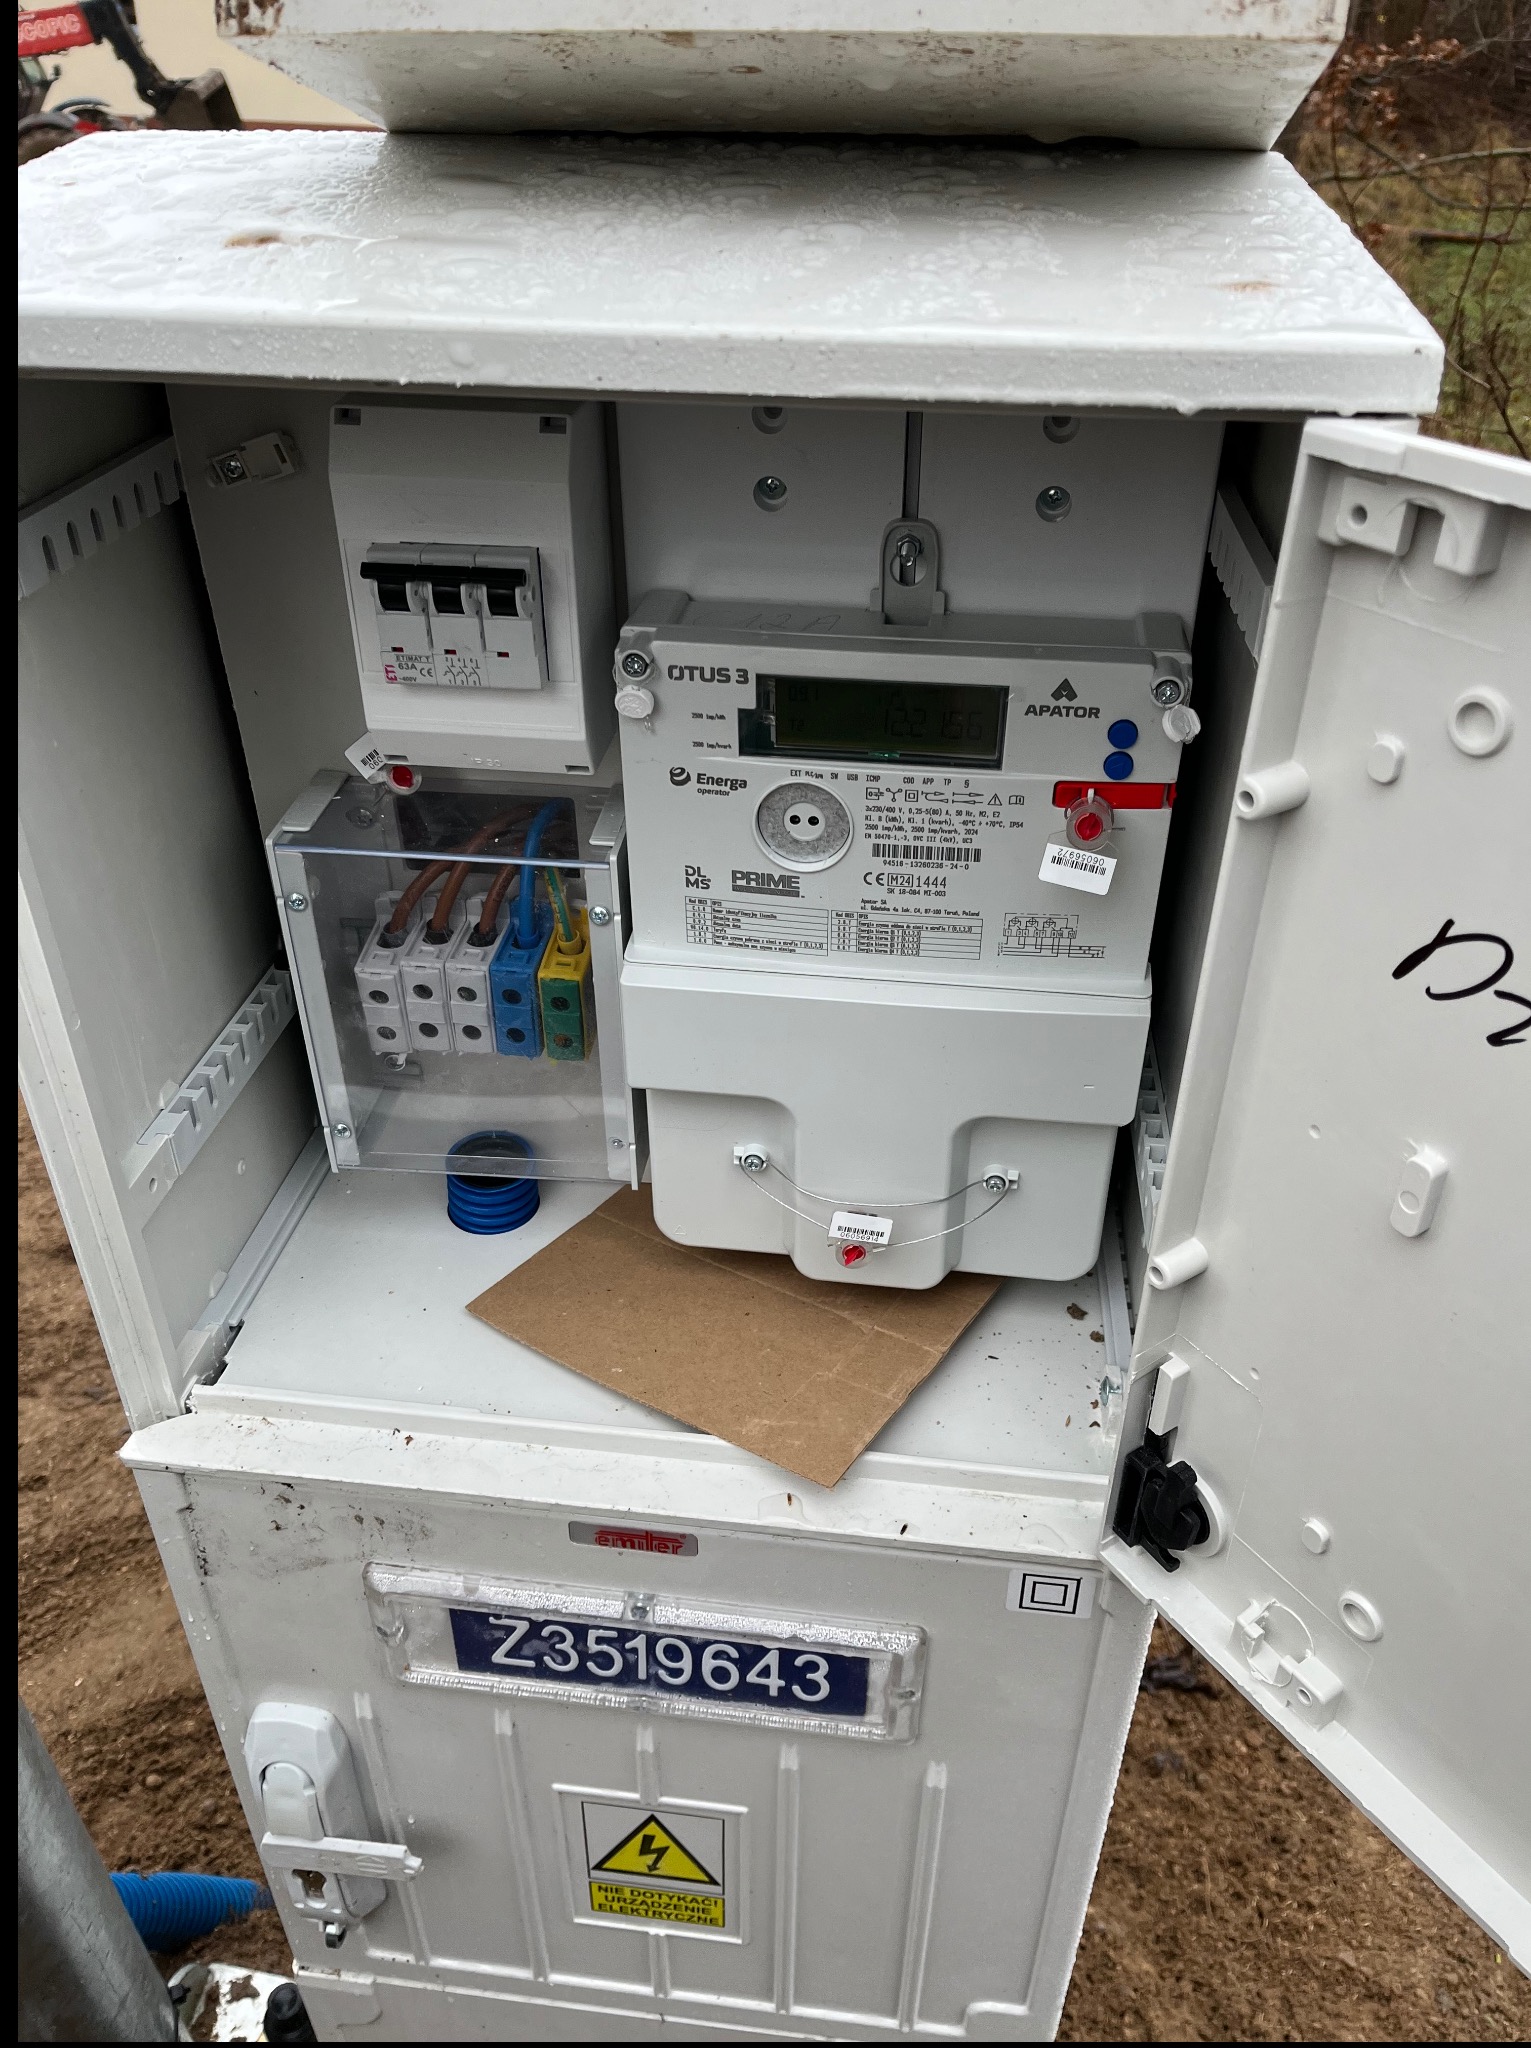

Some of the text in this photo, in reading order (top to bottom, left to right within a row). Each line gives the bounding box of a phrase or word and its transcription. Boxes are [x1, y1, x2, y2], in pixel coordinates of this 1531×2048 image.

[398, 662, 418, 671] 63A
[667, 664, 749, 685] OTUS 3
[1024, 704, 1101, 719] APATOR
[696, 773, 748, 791] Energa
[790, 769, 802, 777] EXT
[847, 773, 859, 781] USB
[865, 774, 881, 782] ICMP
[922, 777, 935, 785] APP
[943, 778, 952, 786] TP
[697, 787, 730, 797] operator
[865, 805, 896, 814] 3x230/400
[908, 807, 943, 817] 0,25-5(80)
[864, 823, 879, 831] 2500
[964, 828, 979, 836] 2024
[958, 819, 976, 827] -40°C
[1009, 821, 1024, 829] IP54
[1056, 847, 1105, 867] 06056972
[731, 869, 801, 890] PRIME
[890, 874, 912, 886] M24
[915, 875, 947, 889] 1444
[898, 888, 921, 896] 18-084
[840, 1231, 879, 1243] 06056914
[488, 1616, 831, 1702] Z3519643
[597, 1885, 625, 1895] NIE
[604, 1895, 712, 1916] URZĄDZENIE
[598, 1903, 719, 1925] ELEKTRYCZNE
